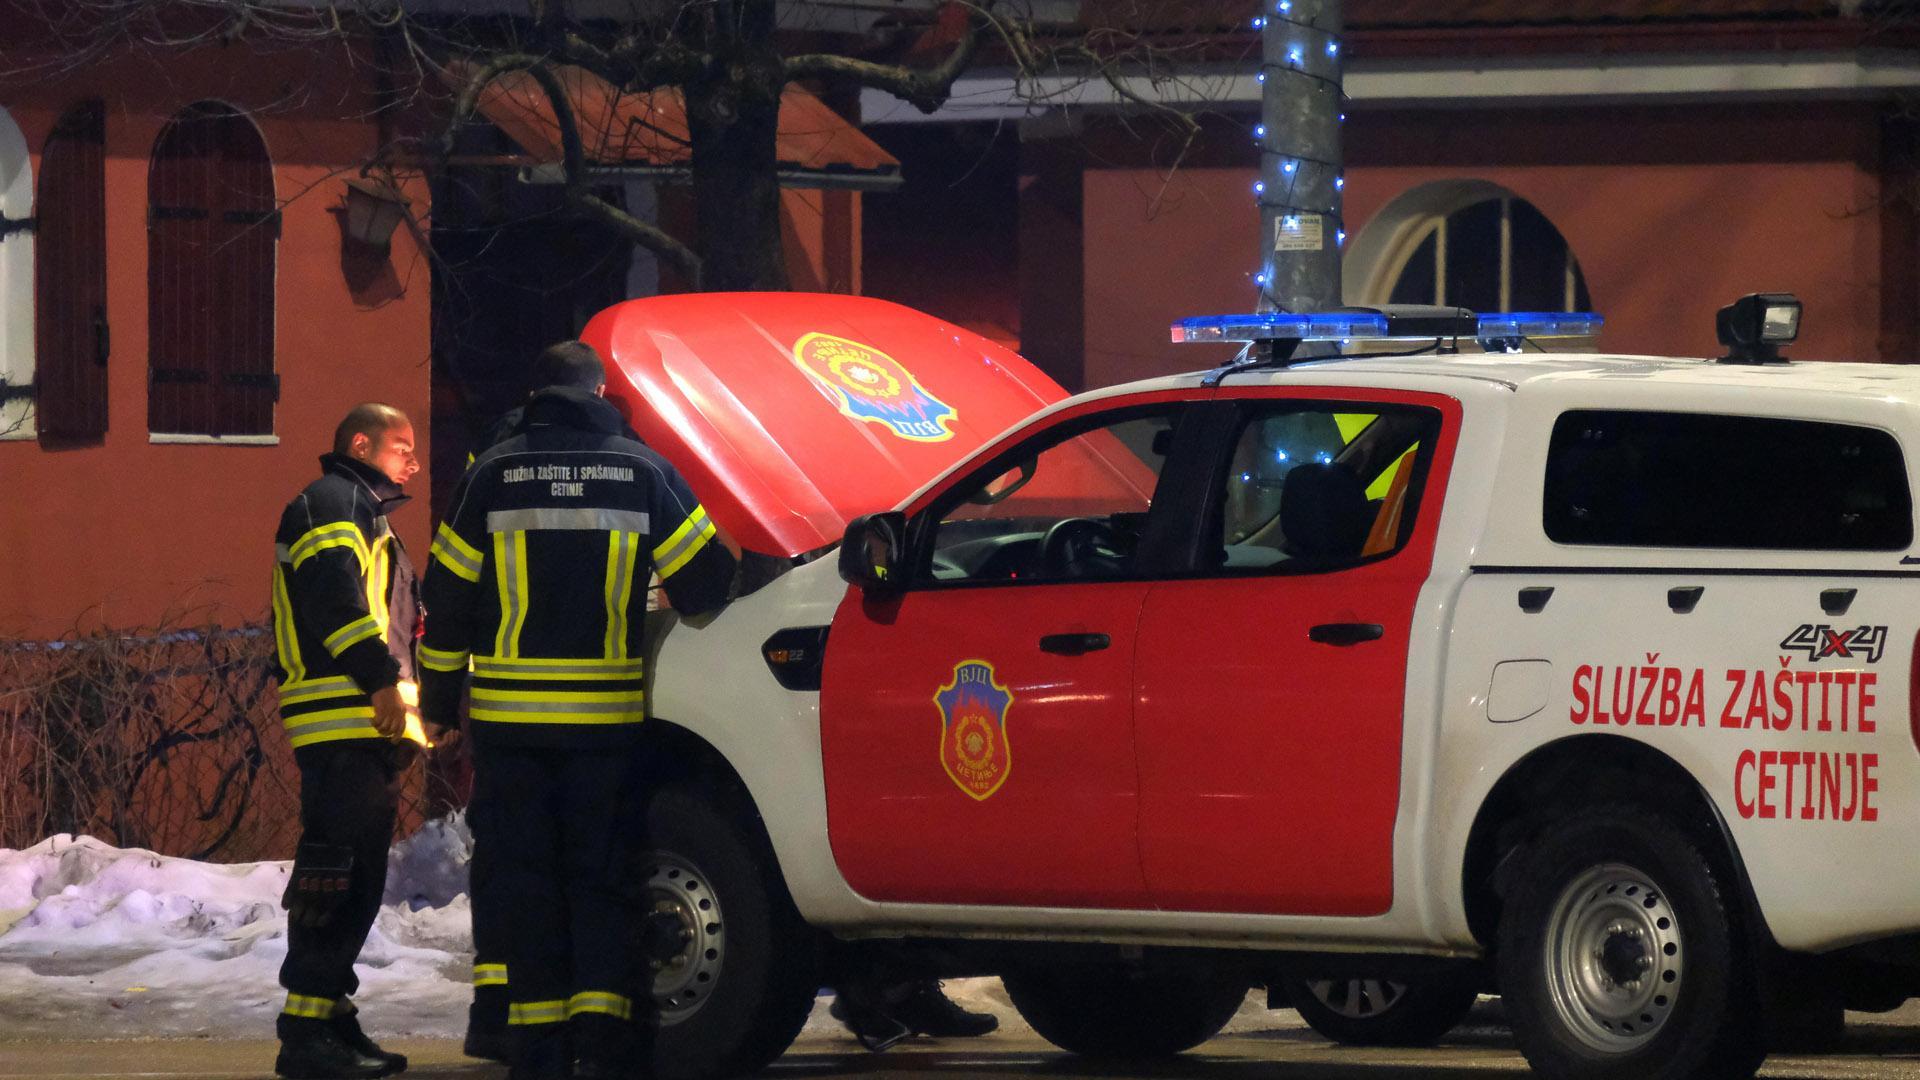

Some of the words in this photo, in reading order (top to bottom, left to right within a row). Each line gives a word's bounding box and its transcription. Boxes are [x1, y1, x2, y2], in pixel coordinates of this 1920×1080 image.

[537, 464, 571, 481] ZAŠTITE
[574, 466, 578, 480] I
[580, 464, 634, 482] SPAŠAVANJA
[551, 482, 584, 497] CETINJE
[1569, 652, 1706, 728] SLUŽBA
[1720, 655, 1878, 734] ZAŠTITE
[1734, 749, 1879, 822] CETINJE
